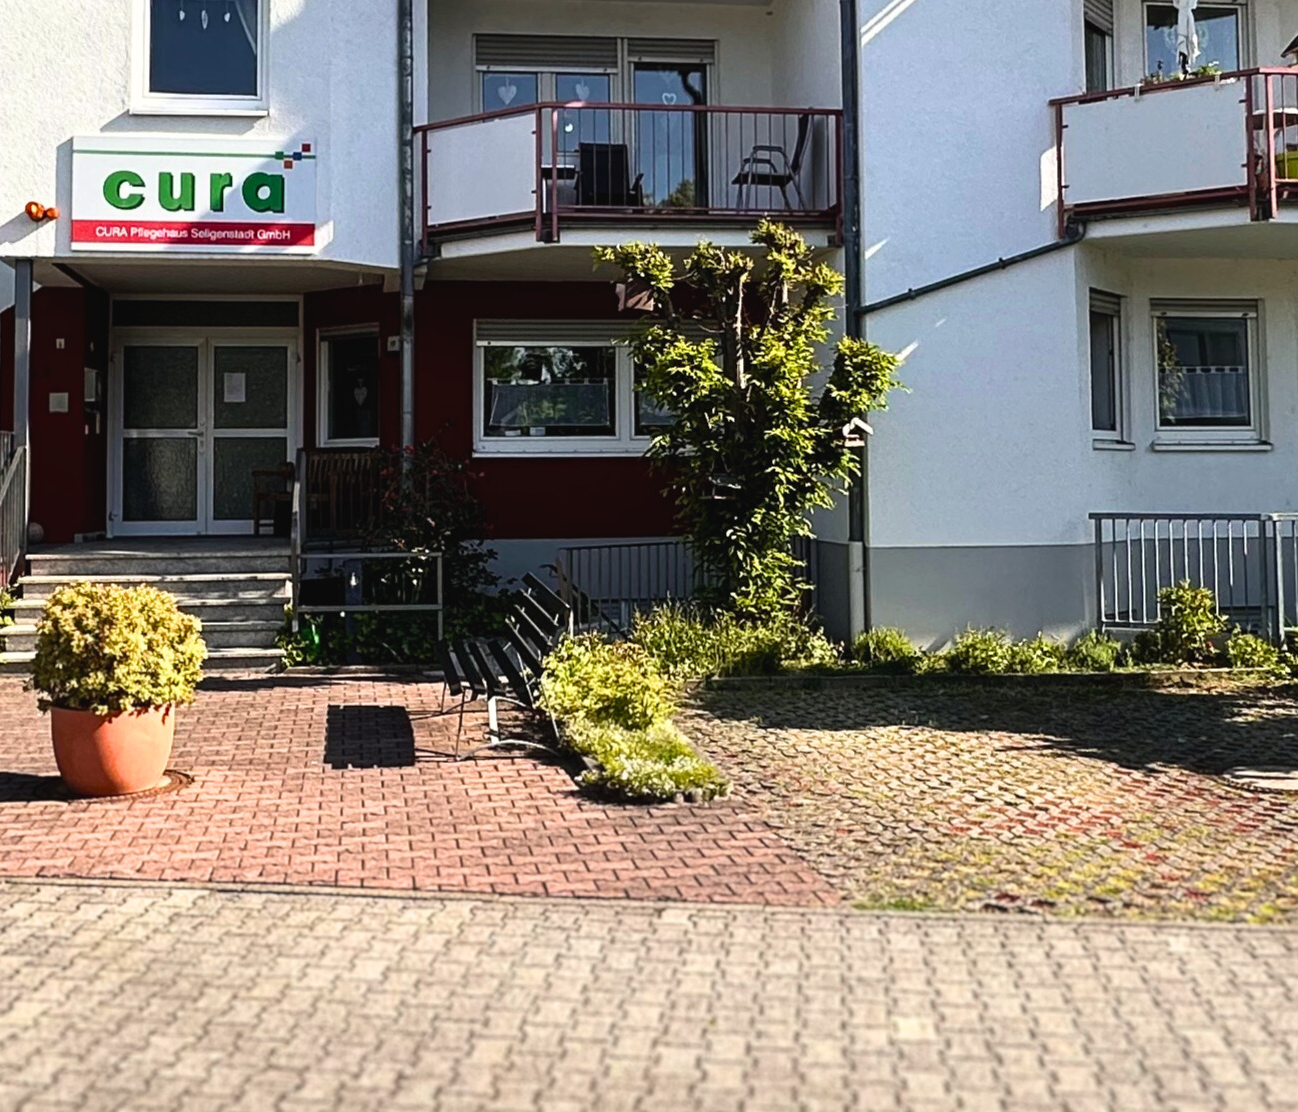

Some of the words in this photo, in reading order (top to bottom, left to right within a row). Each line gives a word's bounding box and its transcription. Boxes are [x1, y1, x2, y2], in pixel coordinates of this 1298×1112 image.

[103, 170, 285, 213] cura
[95, 227, 128, 238] CURA
[130, 227, 189, 240] Pflegehaus
[190, 228, 254, 241] Seligenstadt
[257, 229, 291, 240] GmbH
